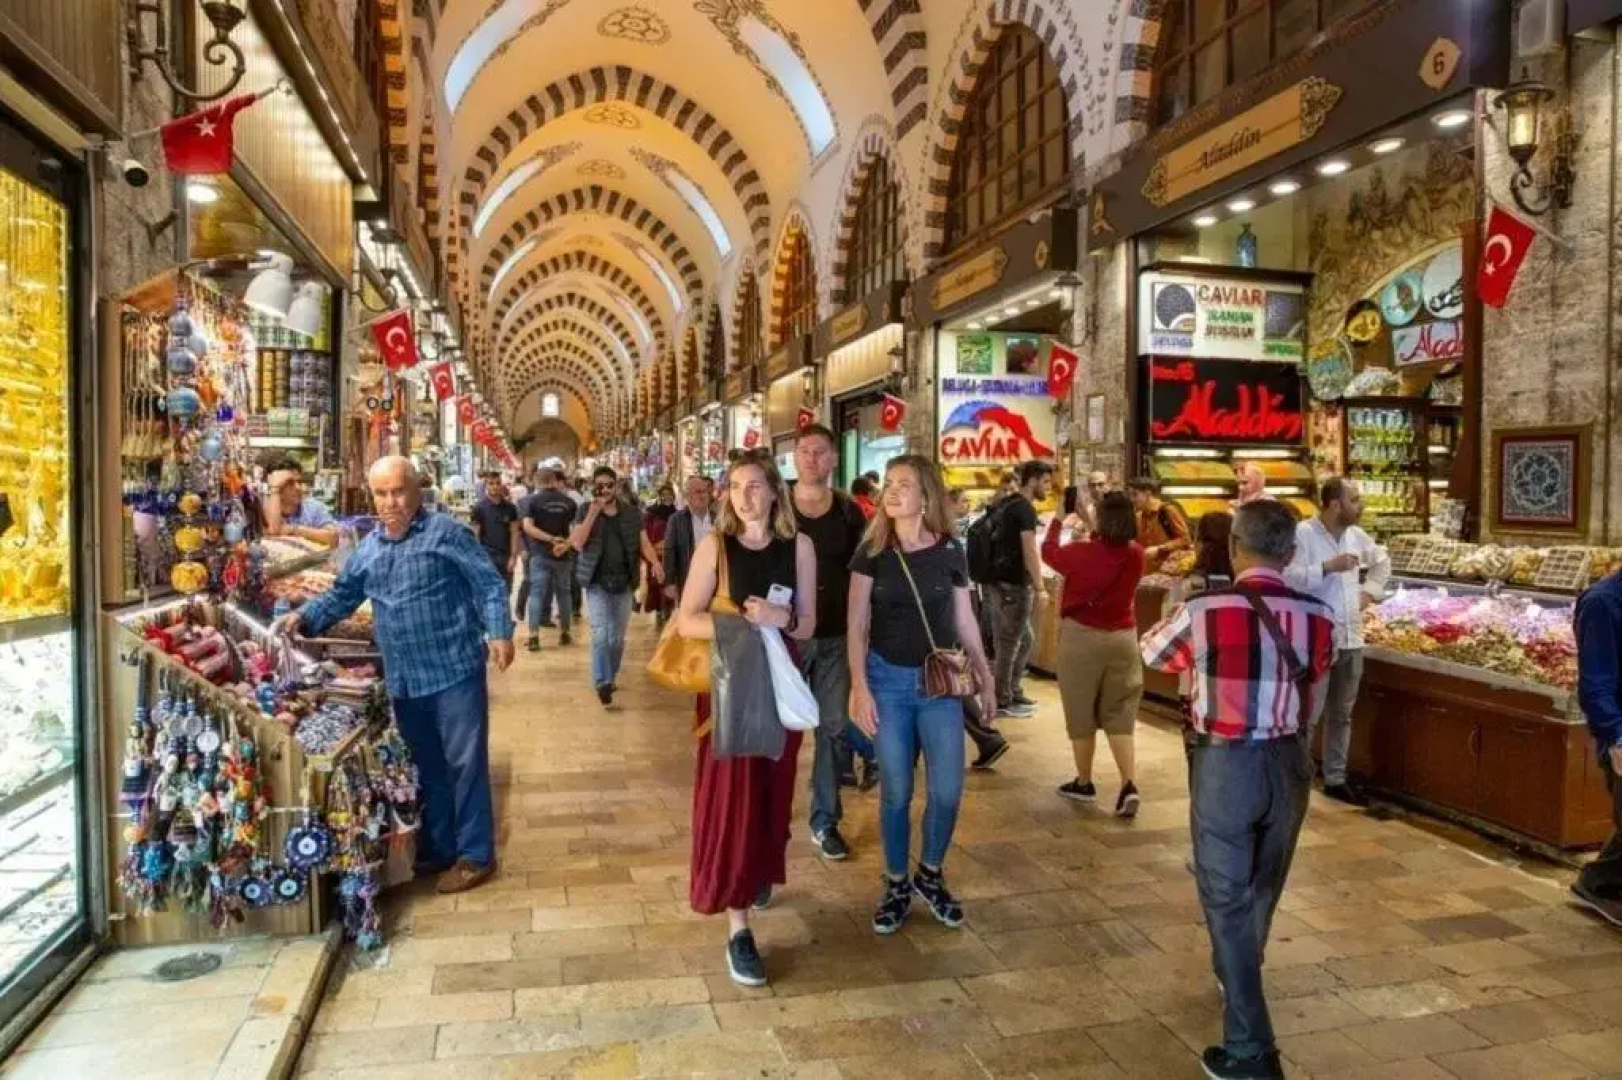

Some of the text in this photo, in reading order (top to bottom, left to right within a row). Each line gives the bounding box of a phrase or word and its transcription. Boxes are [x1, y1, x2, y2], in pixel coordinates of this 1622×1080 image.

[1432, 51, 1445, 76] 6
[1199, 284, 1267, 306] CAVIAR
[1151, 379, 1304, 440] Aladdin
[941, 426, 1020, 459] CAVIAR
